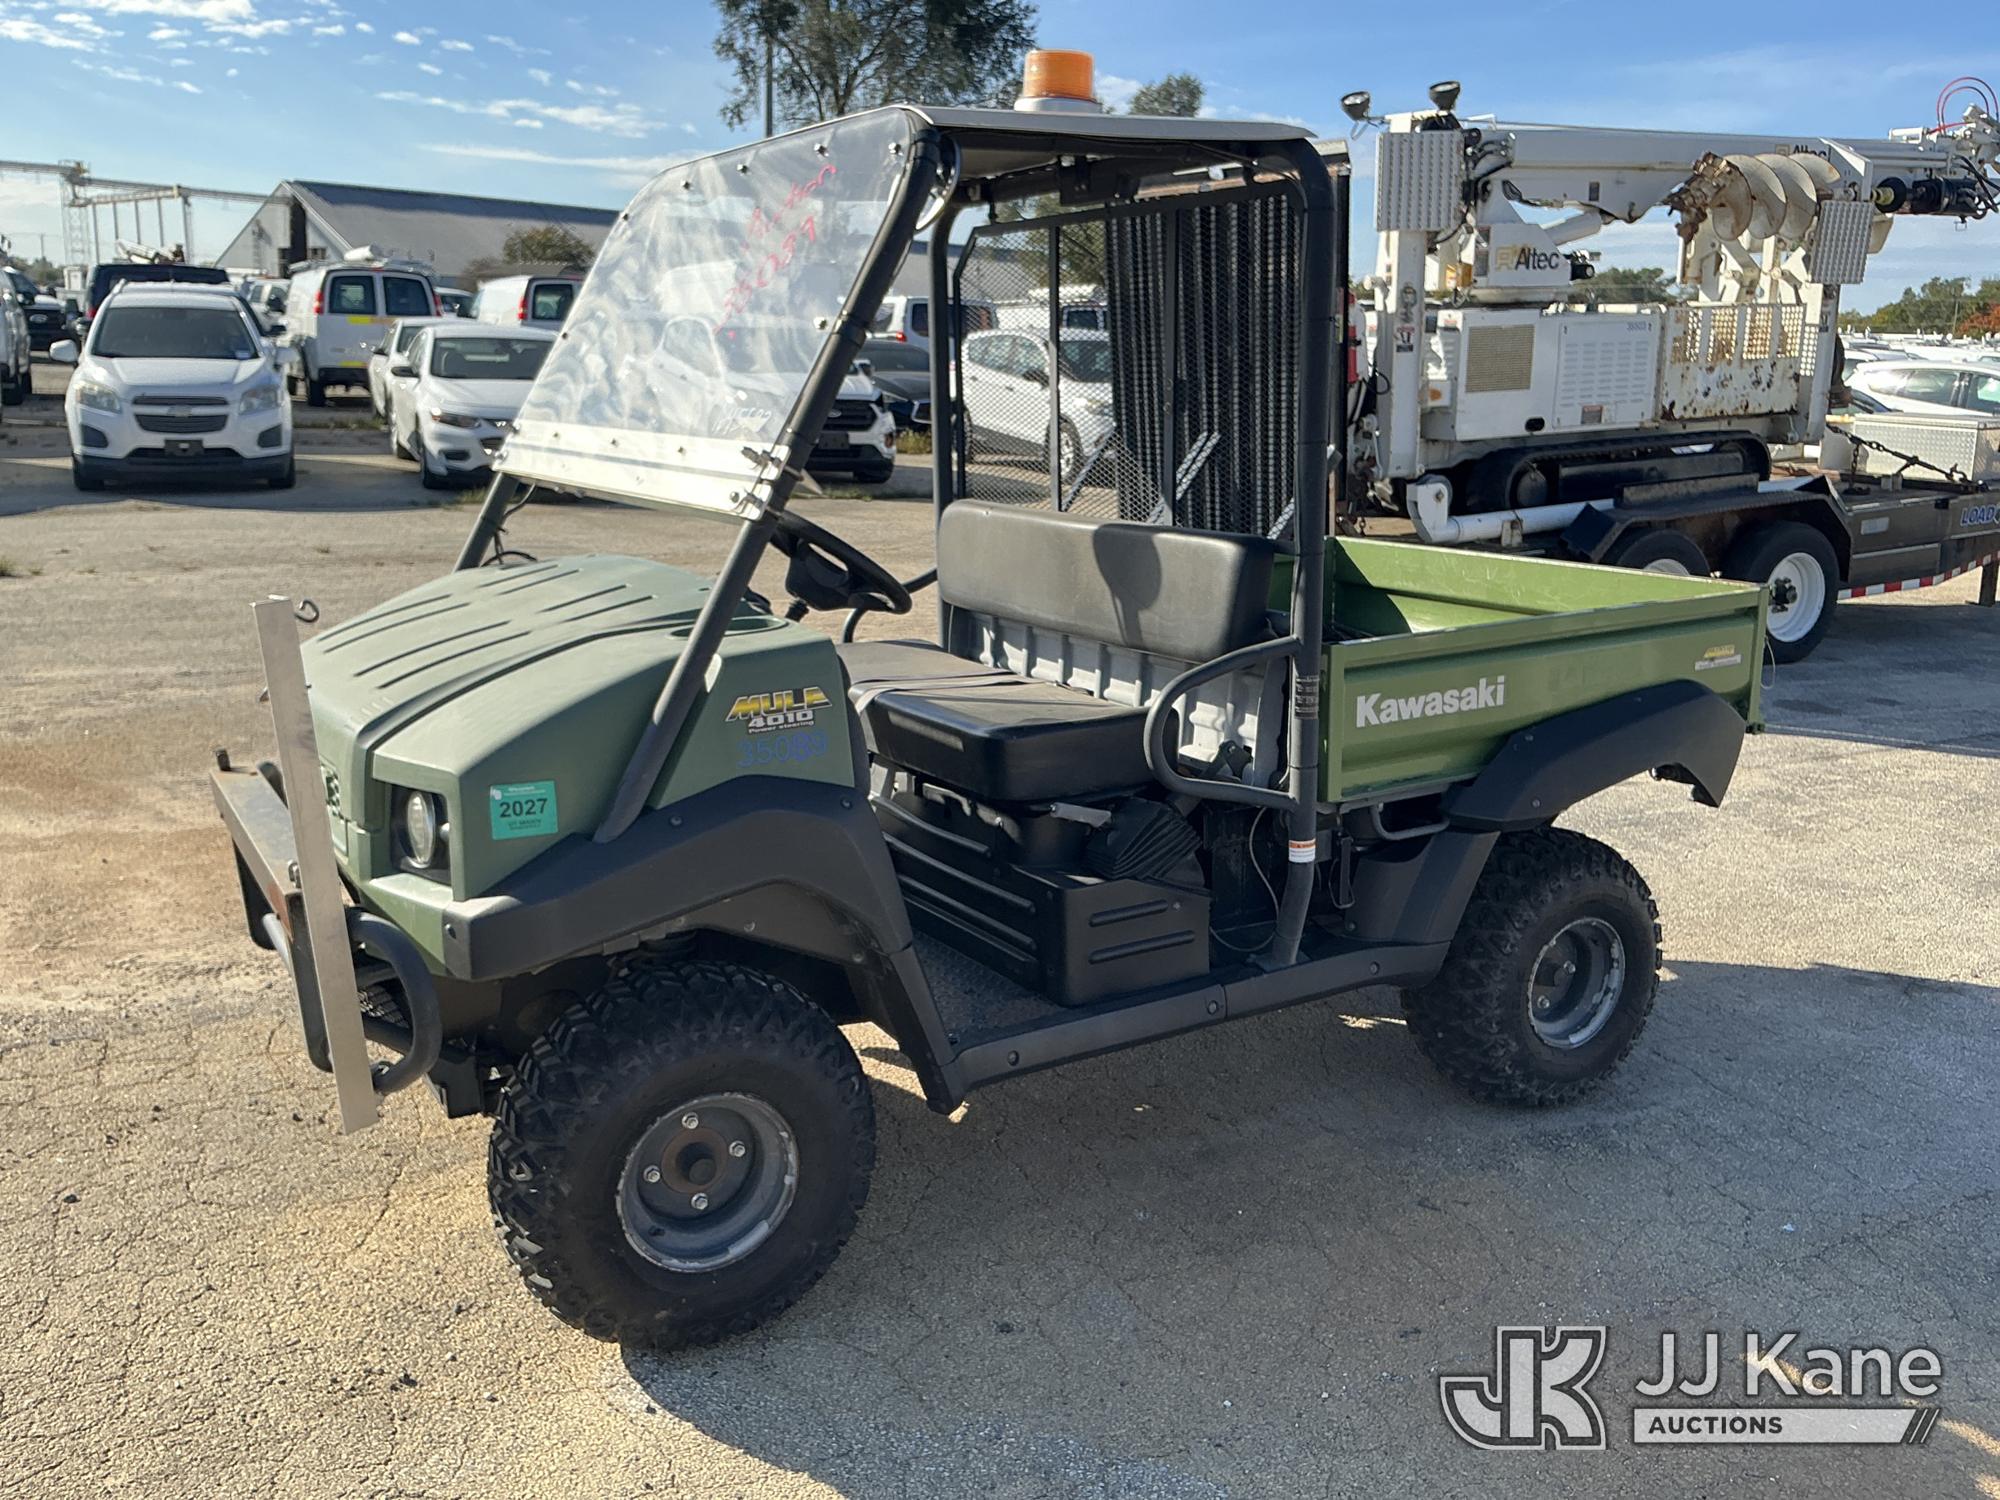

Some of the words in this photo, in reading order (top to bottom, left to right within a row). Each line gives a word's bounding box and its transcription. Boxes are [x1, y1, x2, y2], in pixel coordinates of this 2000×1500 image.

[1514, 247, 1560, 271] Altec
[725, 686, 833, 723] MULE
[1355, 674, 1506, 729] Kawasaki
[748, 709, 814, 728] 4010
[499, 797, 549, 818] 2027
